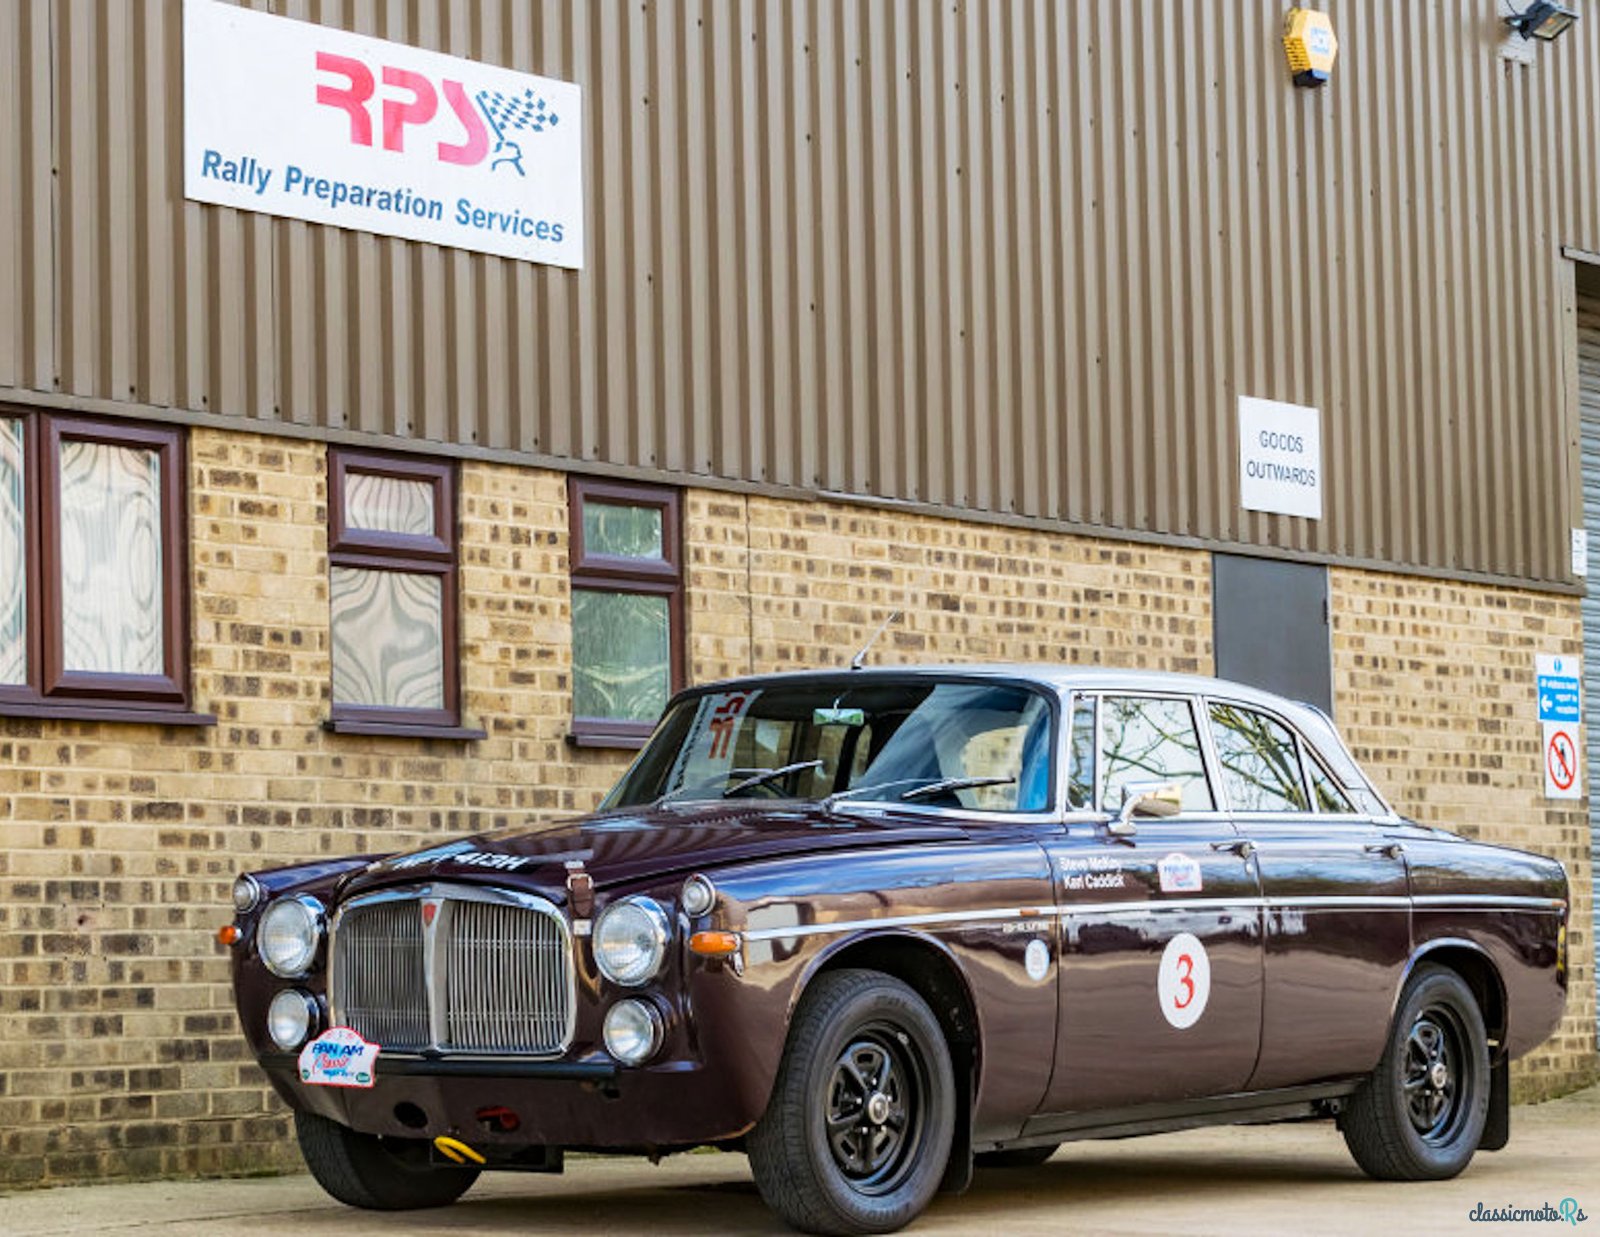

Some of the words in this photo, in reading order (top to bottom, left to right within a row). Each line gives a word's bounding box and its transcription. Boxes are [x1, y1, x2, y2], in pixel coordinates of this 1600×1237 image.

[316, 51, 489, 166] RPS
[201, 149, 272, 195] Rally
[284, 165, 443, 220] Preparation
[456, 197, 564, 242] Services
[1246, 460, 1316, 487] OUTWARDS
[1174, 953, 1196, 1009] 3
